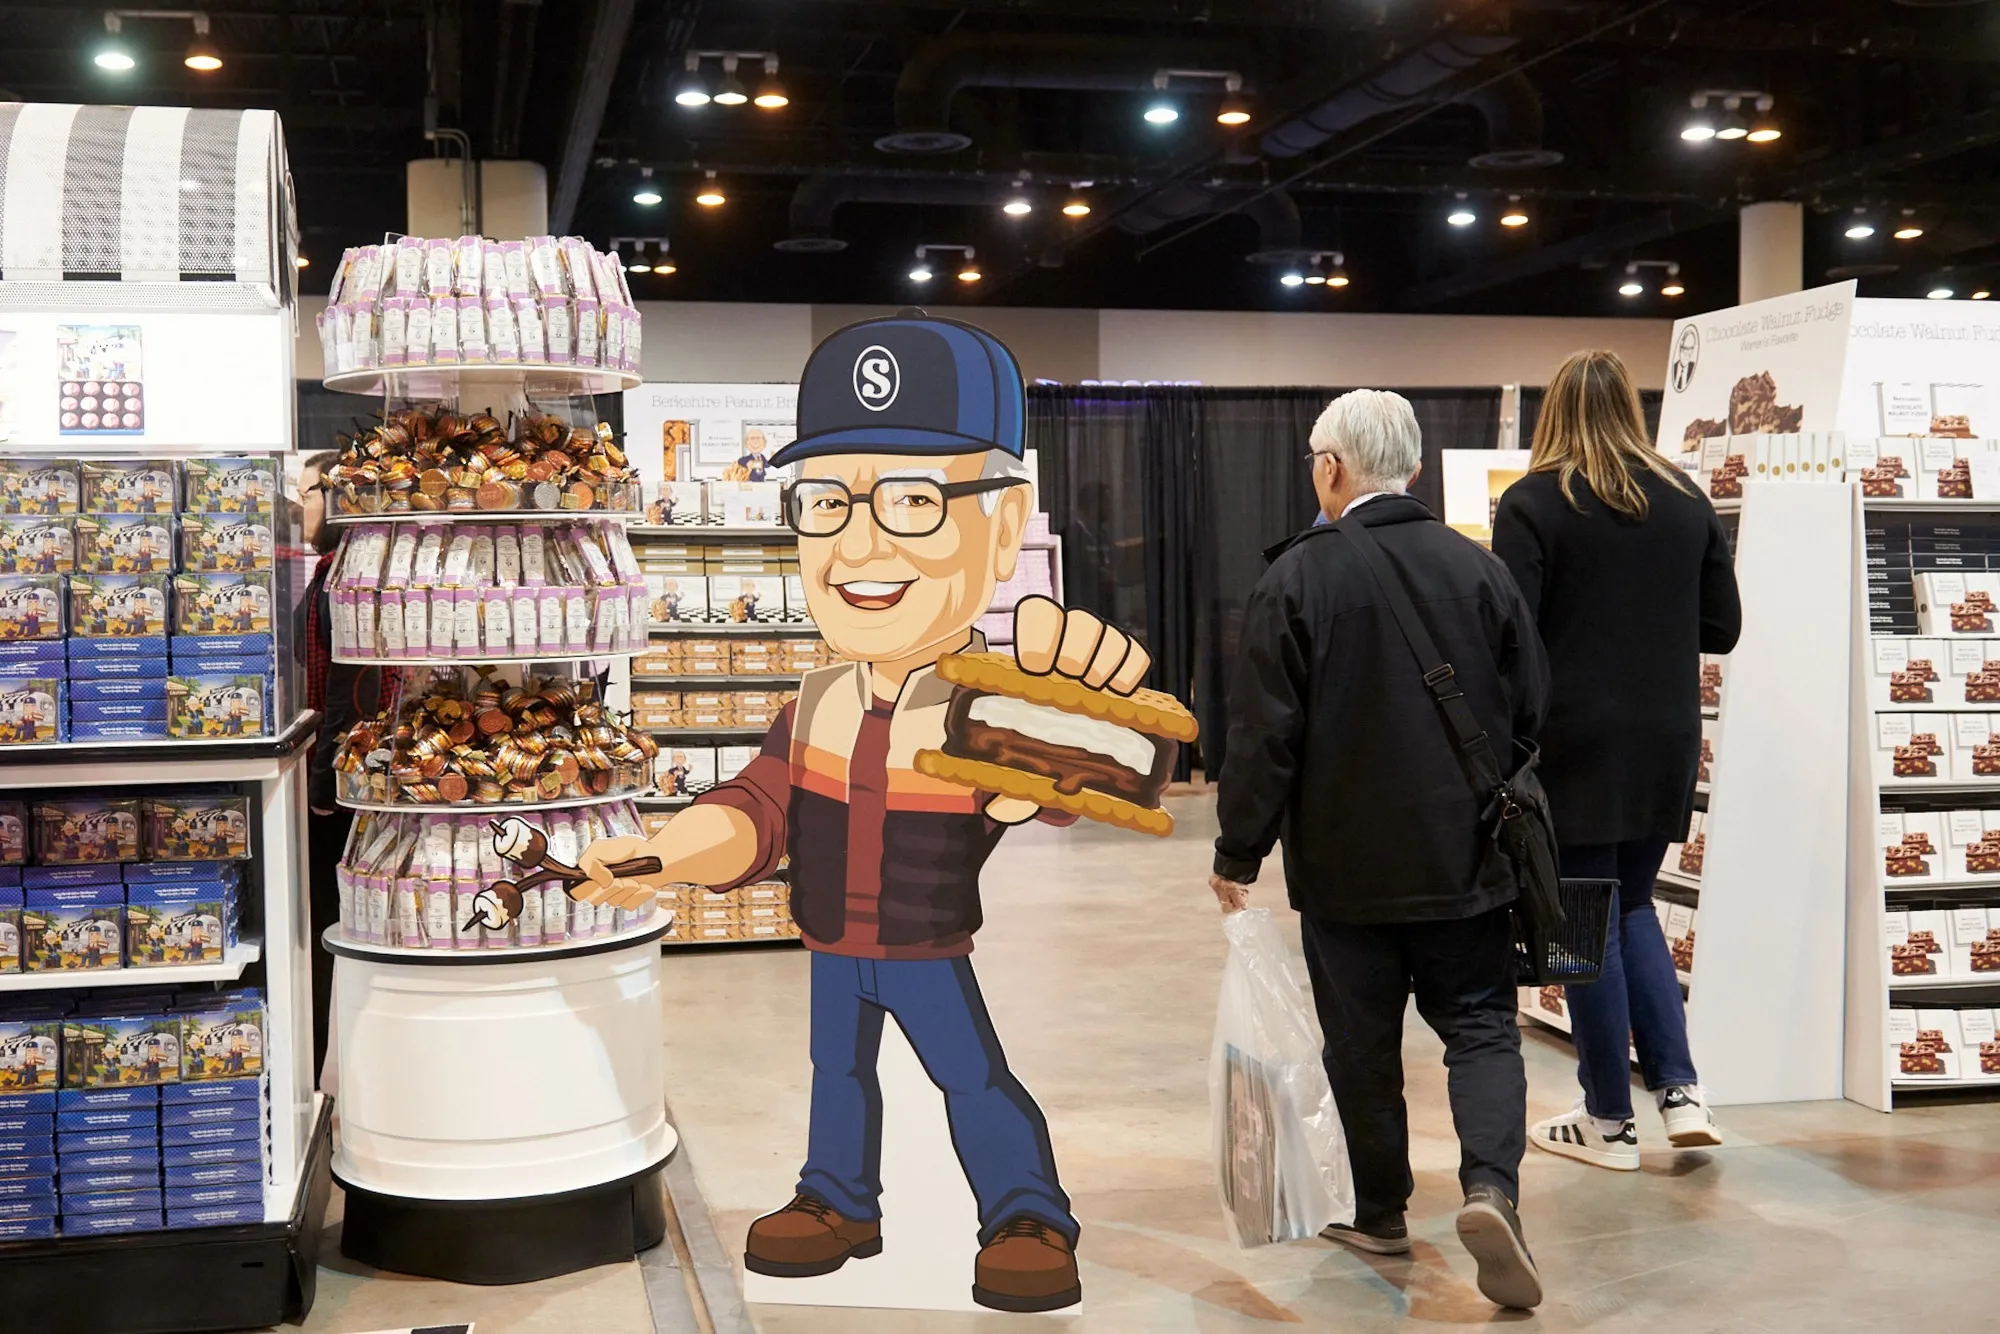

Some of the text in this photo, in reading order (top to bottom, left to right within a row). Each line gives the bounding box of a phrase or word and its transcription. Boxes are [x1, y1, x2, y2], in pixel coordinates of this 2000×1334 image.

[1705, 301, 1844, 343] Chocolate Walnut Fudge
[1909, 322, 1968, 341] Walnut
[862, 358, 891, 399] S
[652, 394, 721, 409] Berkshire
[725, 395, 772, 409] Peanut
